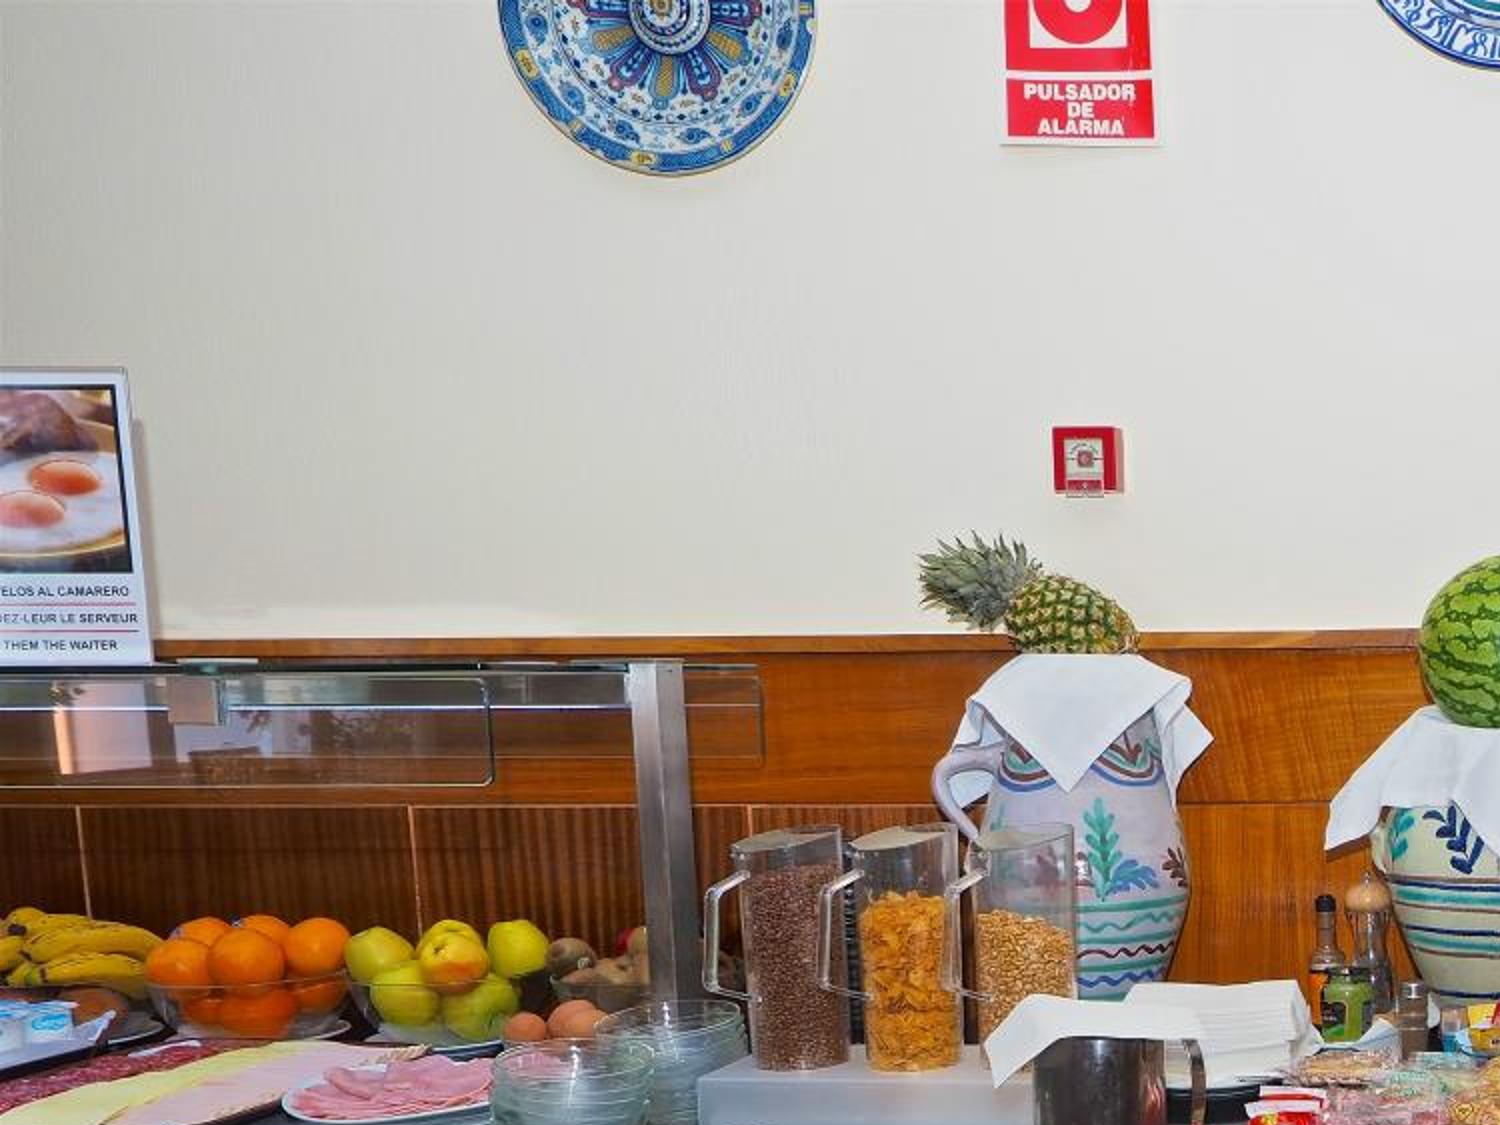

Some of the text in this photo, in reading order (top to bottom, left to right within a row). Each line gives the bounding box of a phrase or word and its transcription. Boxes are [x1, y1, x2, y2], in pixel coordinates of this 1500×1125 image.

[1023, 83, 1136, 101] PULSADOR
[1067, 101, 1095, 118] DE
[1038, 118, 1125, 135] ALARMA
[0, 586, 129, 597] ELOS AL CAMARERO
[61, 613, 75, 624] LE
[79, 613, 139, 624] SERVEUR
[4, 640, 118, 651] THEM THE WAITER
